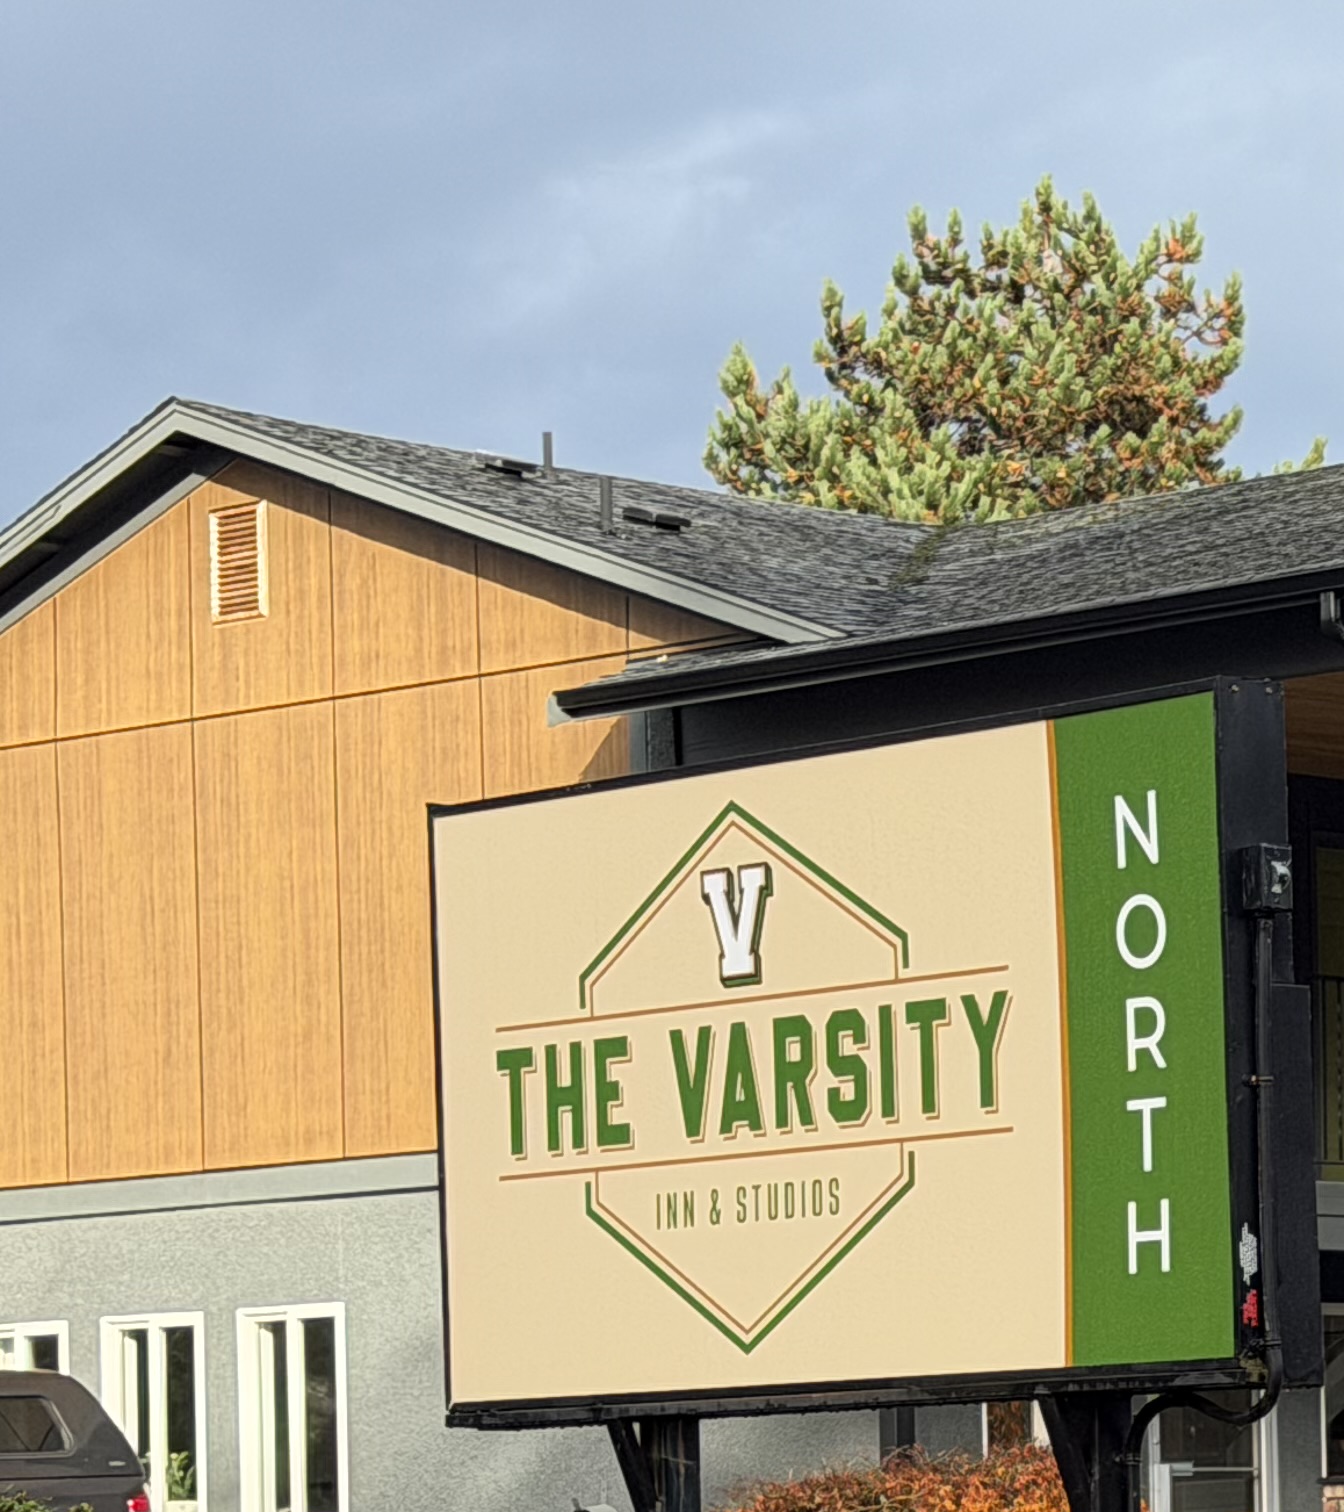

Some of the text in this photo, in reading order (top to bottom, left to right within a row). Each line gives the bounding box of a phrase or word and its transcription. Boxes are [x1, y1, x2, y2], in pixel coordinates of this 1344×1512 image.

[700, 861, 773, 987] V
[495, 989, 1012, 1162] THE VARSITY
[1113, 789, 1173, 1276] NORTH
[654, 1177, 842, 1231] INN & STUDIOS
